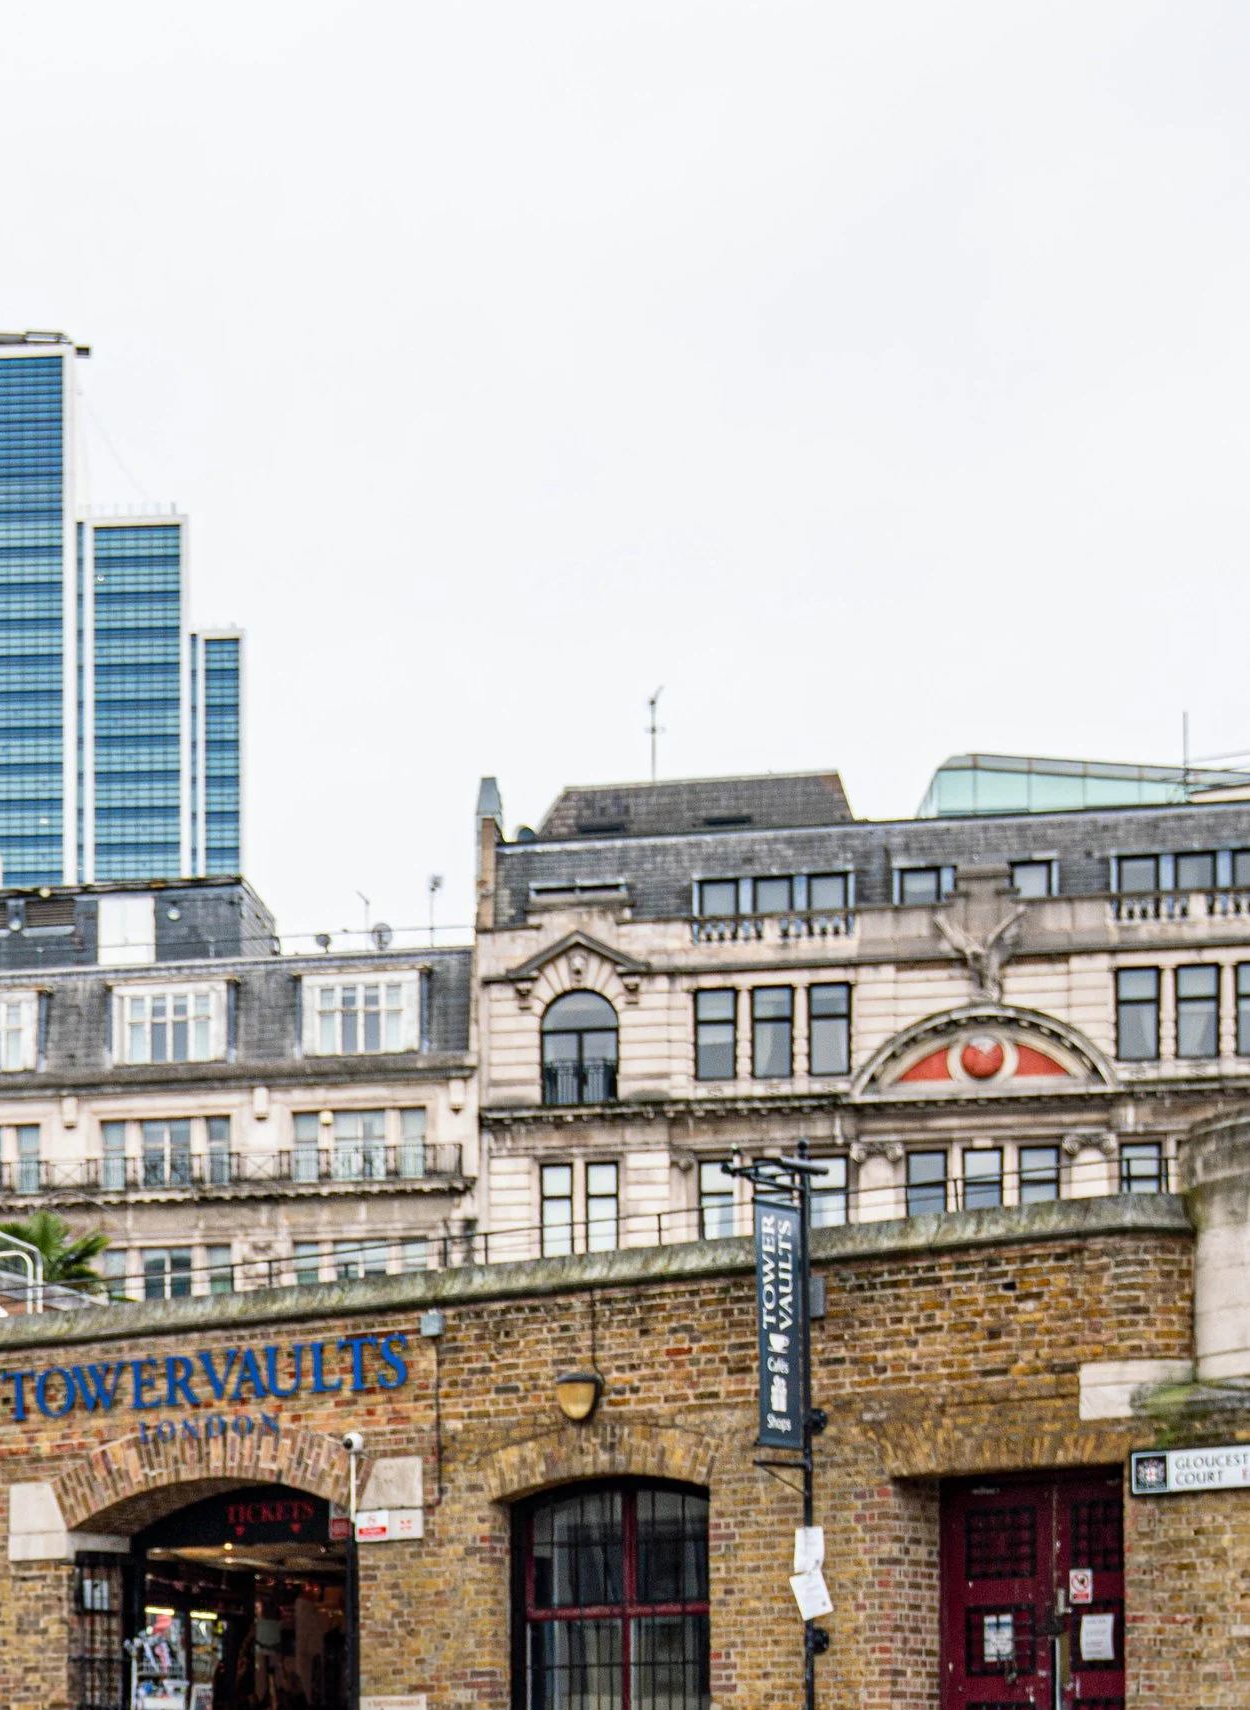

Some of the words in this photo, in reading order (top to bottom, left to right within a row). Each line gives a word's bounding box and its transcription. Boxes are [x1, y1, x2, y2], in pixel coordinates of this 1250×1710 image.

[761, 1214, 777, 1330] TOWER
[778, 1219, 793, 1331] VAULTS
[139, 1412, 282, 1444] LONDON
[766, 1413, 792, 1434] Shops
[1175, 1470, 1223, 1485] COURT
